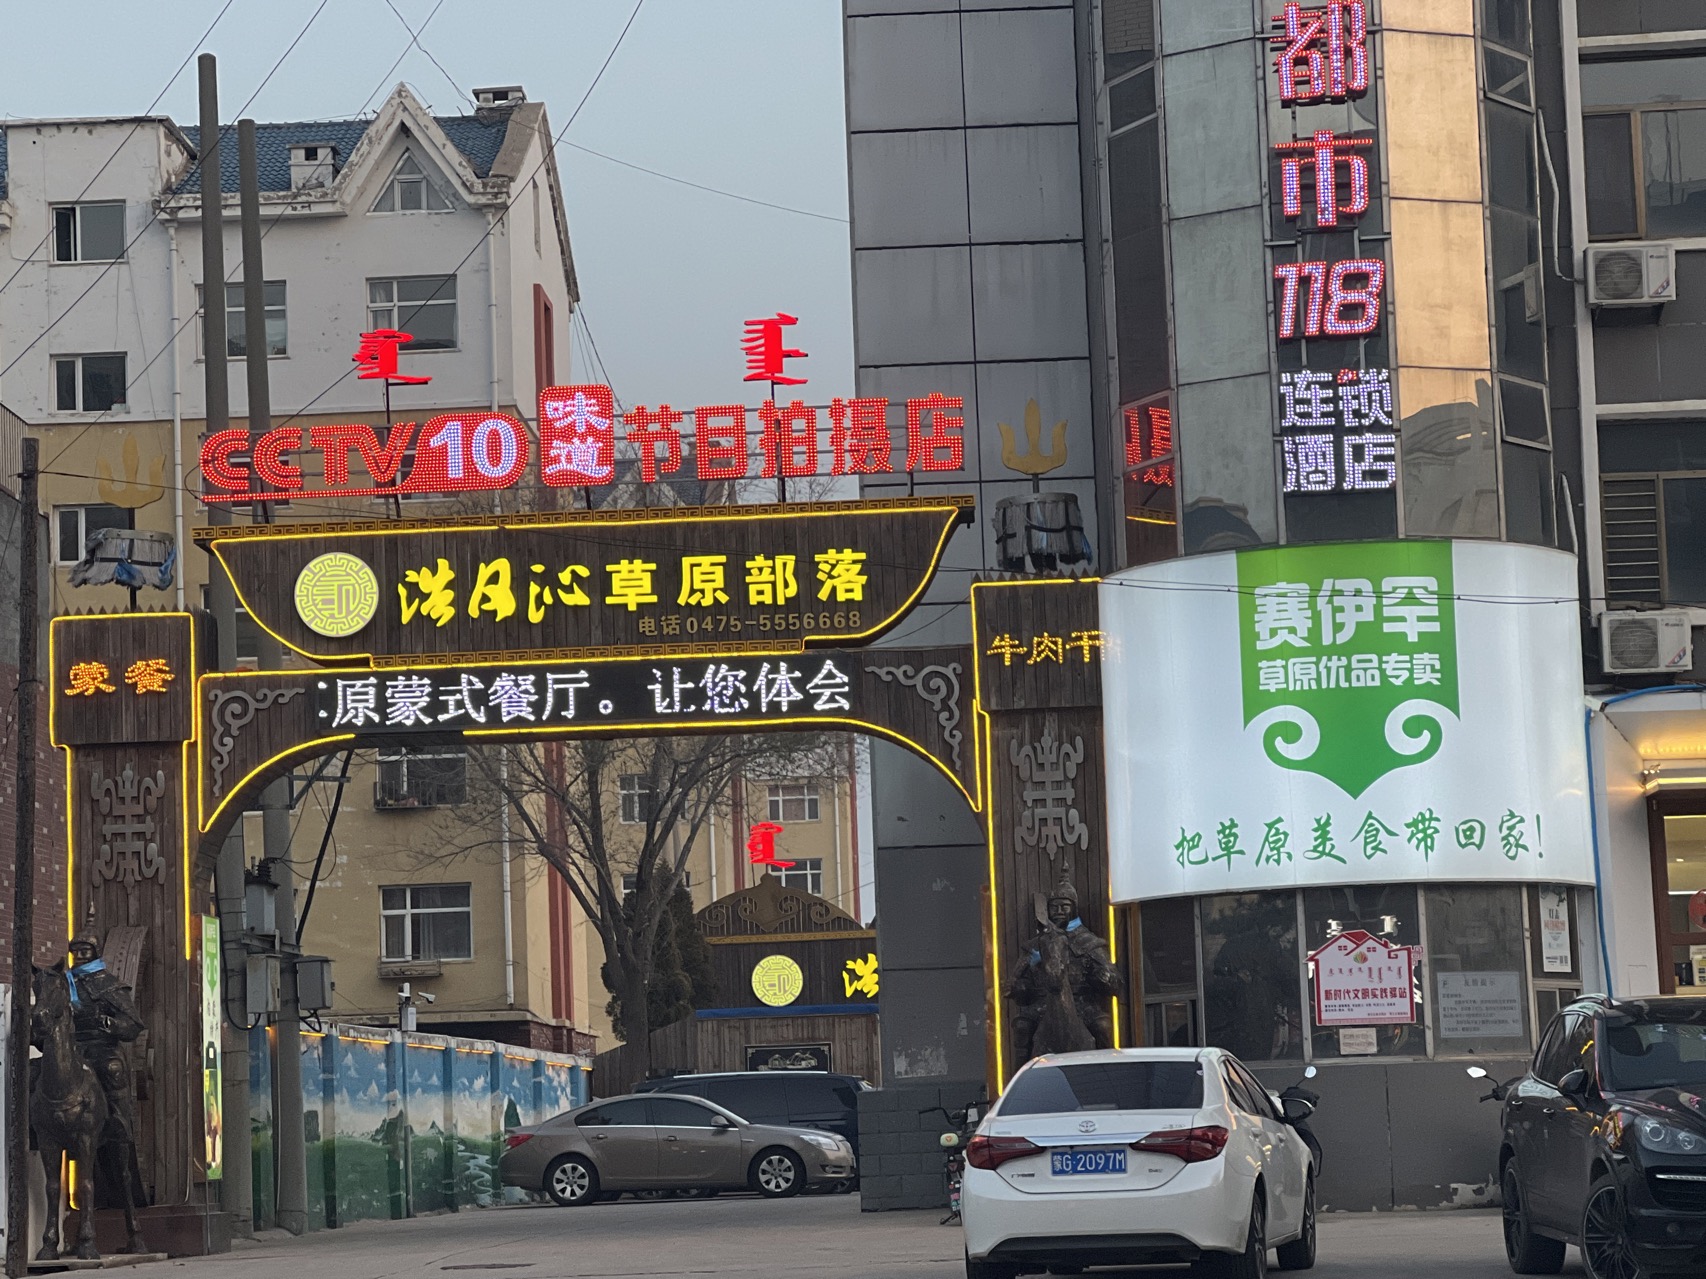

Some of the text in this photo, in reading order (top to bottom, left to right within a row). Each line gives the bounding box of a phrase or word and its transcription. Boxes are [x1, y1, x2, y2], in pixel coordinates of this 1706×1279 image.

[1269, 0, 1373, 227] 都市
[1274, 258, 1385, 339] 118
[1280, 368, 1393, 427] 连锁
[544, 391, 612, 478] 味道
[623, 392, 965, 483] 节目拍摄店
[1283, 433, 1397, 492] 酒店
[1254, 576, 1441, 651] 赛伊罕
[986, 631, 1105, 667] 牛肉干
[1257, 652, 1442, 693] 草原优品专卖
[1324, 986, 1408, 1001] 新时代文明实践驿站
